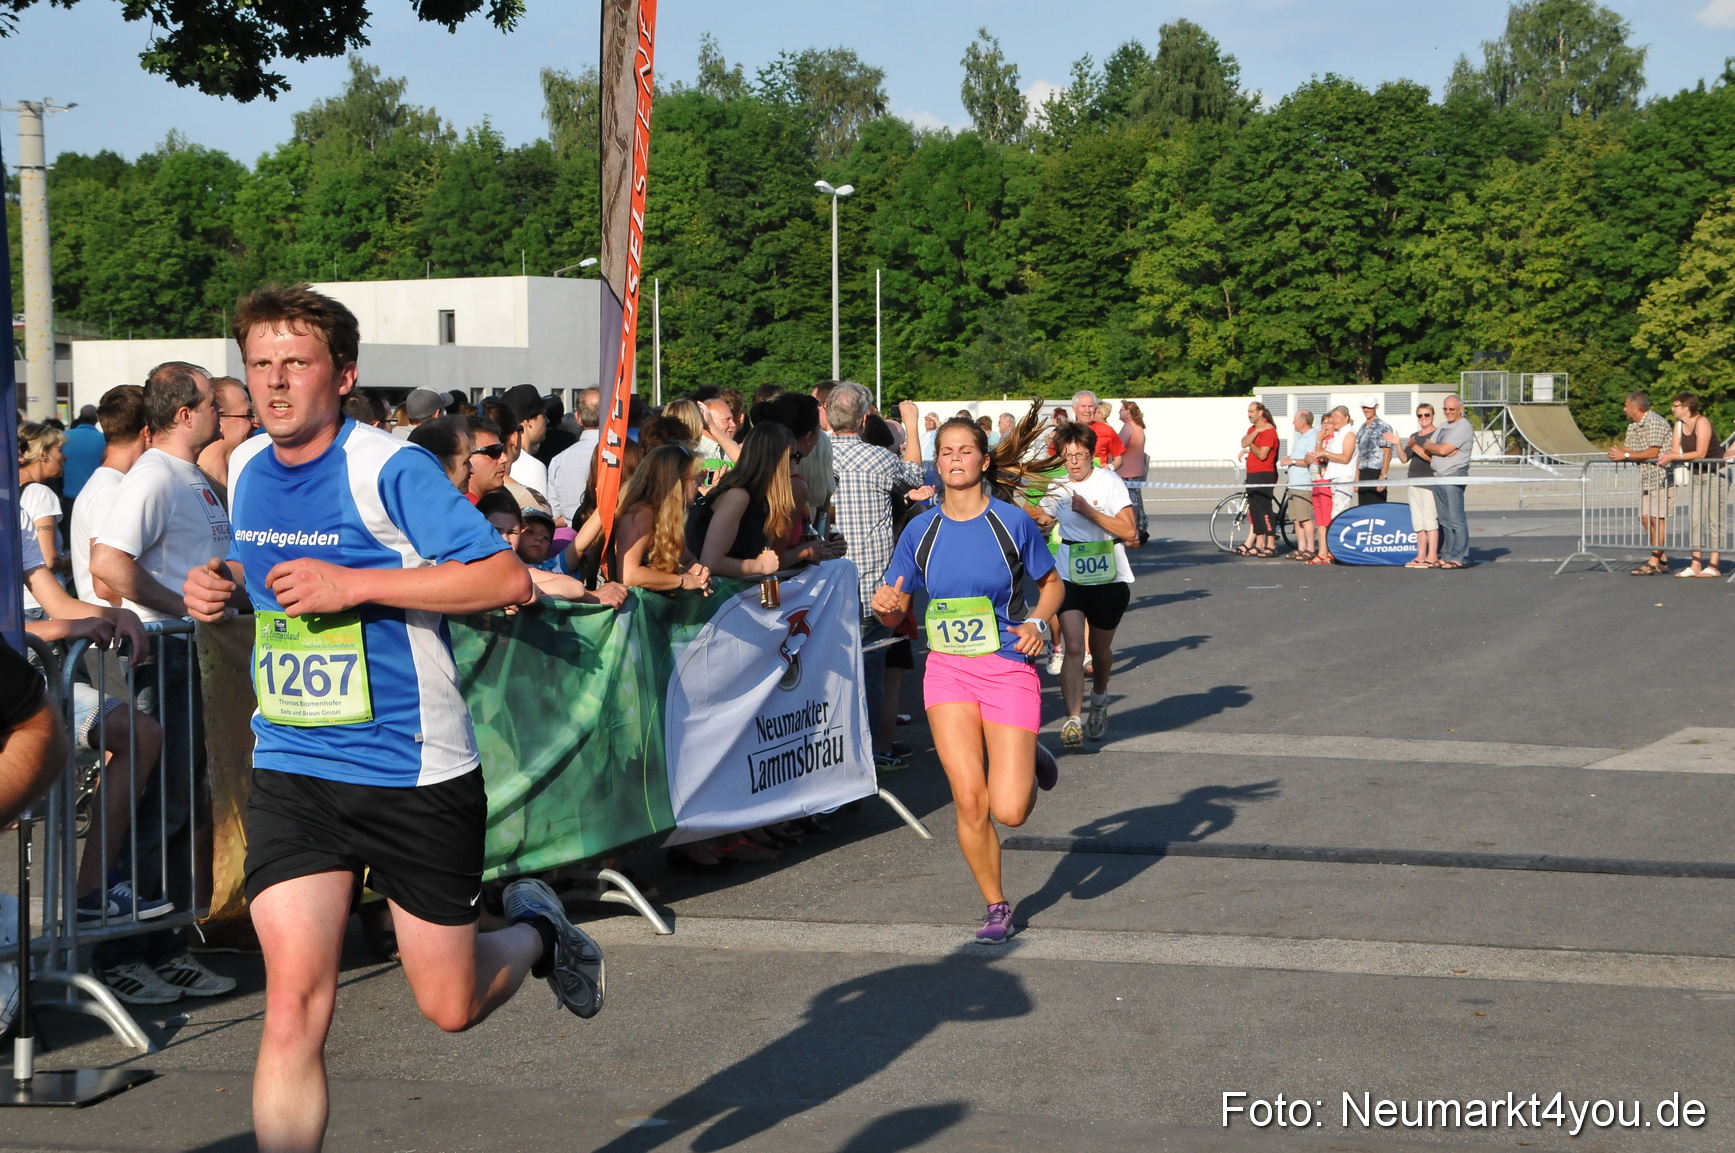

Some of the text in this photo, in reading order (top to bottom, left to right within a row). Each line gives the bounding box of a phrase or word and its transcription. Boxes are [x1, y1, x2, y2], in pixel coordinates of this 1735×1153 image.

[235, 528, 339, 547] energiegeladen
[1355, 529, 1418, 546] Fische
[1362, 545, 1418, 553] AUTOMOBIL
[1075, 555, 1109, 575] 904
[936, 618, 987, 643] 132
[259, 651, 358, 698] 1267
[278, 698, 299, 707] Thomas
[755, 700, 829, 744] Neumarkter
[747, 728, 844, 795] Lammsbräu
